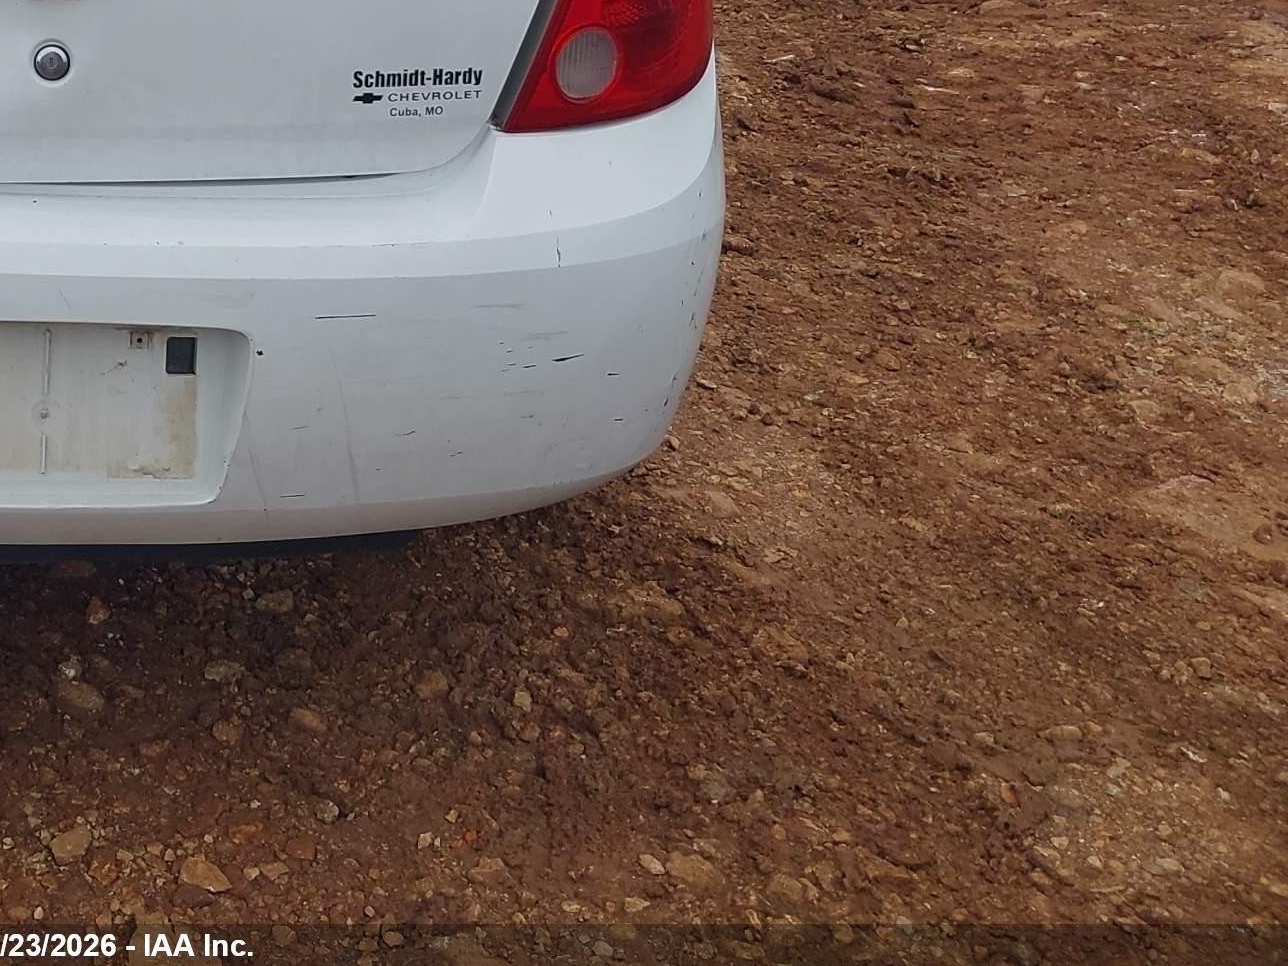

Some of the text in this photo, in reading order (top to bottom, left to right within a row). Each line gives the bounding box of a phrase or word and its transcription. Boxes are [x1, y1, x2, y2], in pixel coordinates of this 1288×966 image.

[352, 67, 483, 88] Schmidt-Hardy
[387, 90, 482, 102] CHEVROLET
[389, 106, 444, 117] Cuba, MO
